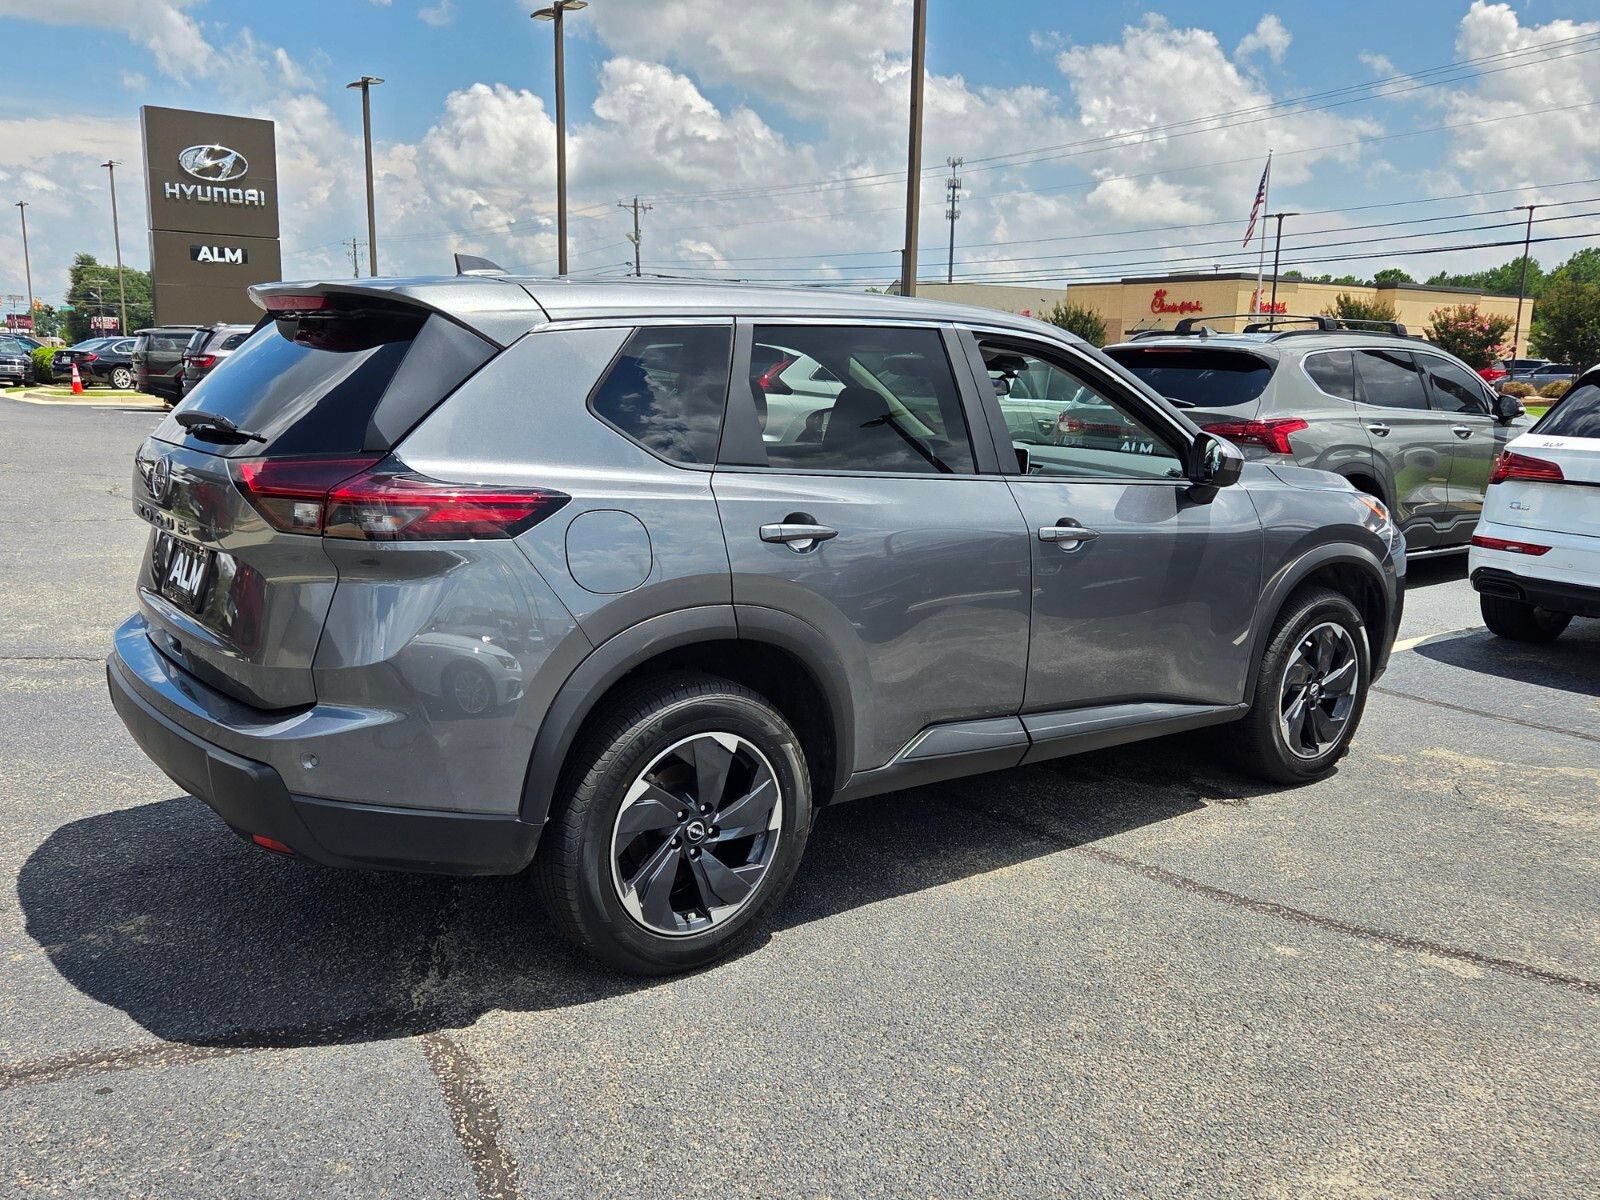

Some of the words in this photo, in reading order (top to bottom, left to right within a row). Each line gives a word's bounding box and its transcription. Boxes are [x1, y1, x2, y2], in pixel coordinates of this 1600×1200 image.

[164, 182, 265, 206] HYUNDAI
[197, 246, 243, 264] ALM
[169, 552, 205, 596] ALM
